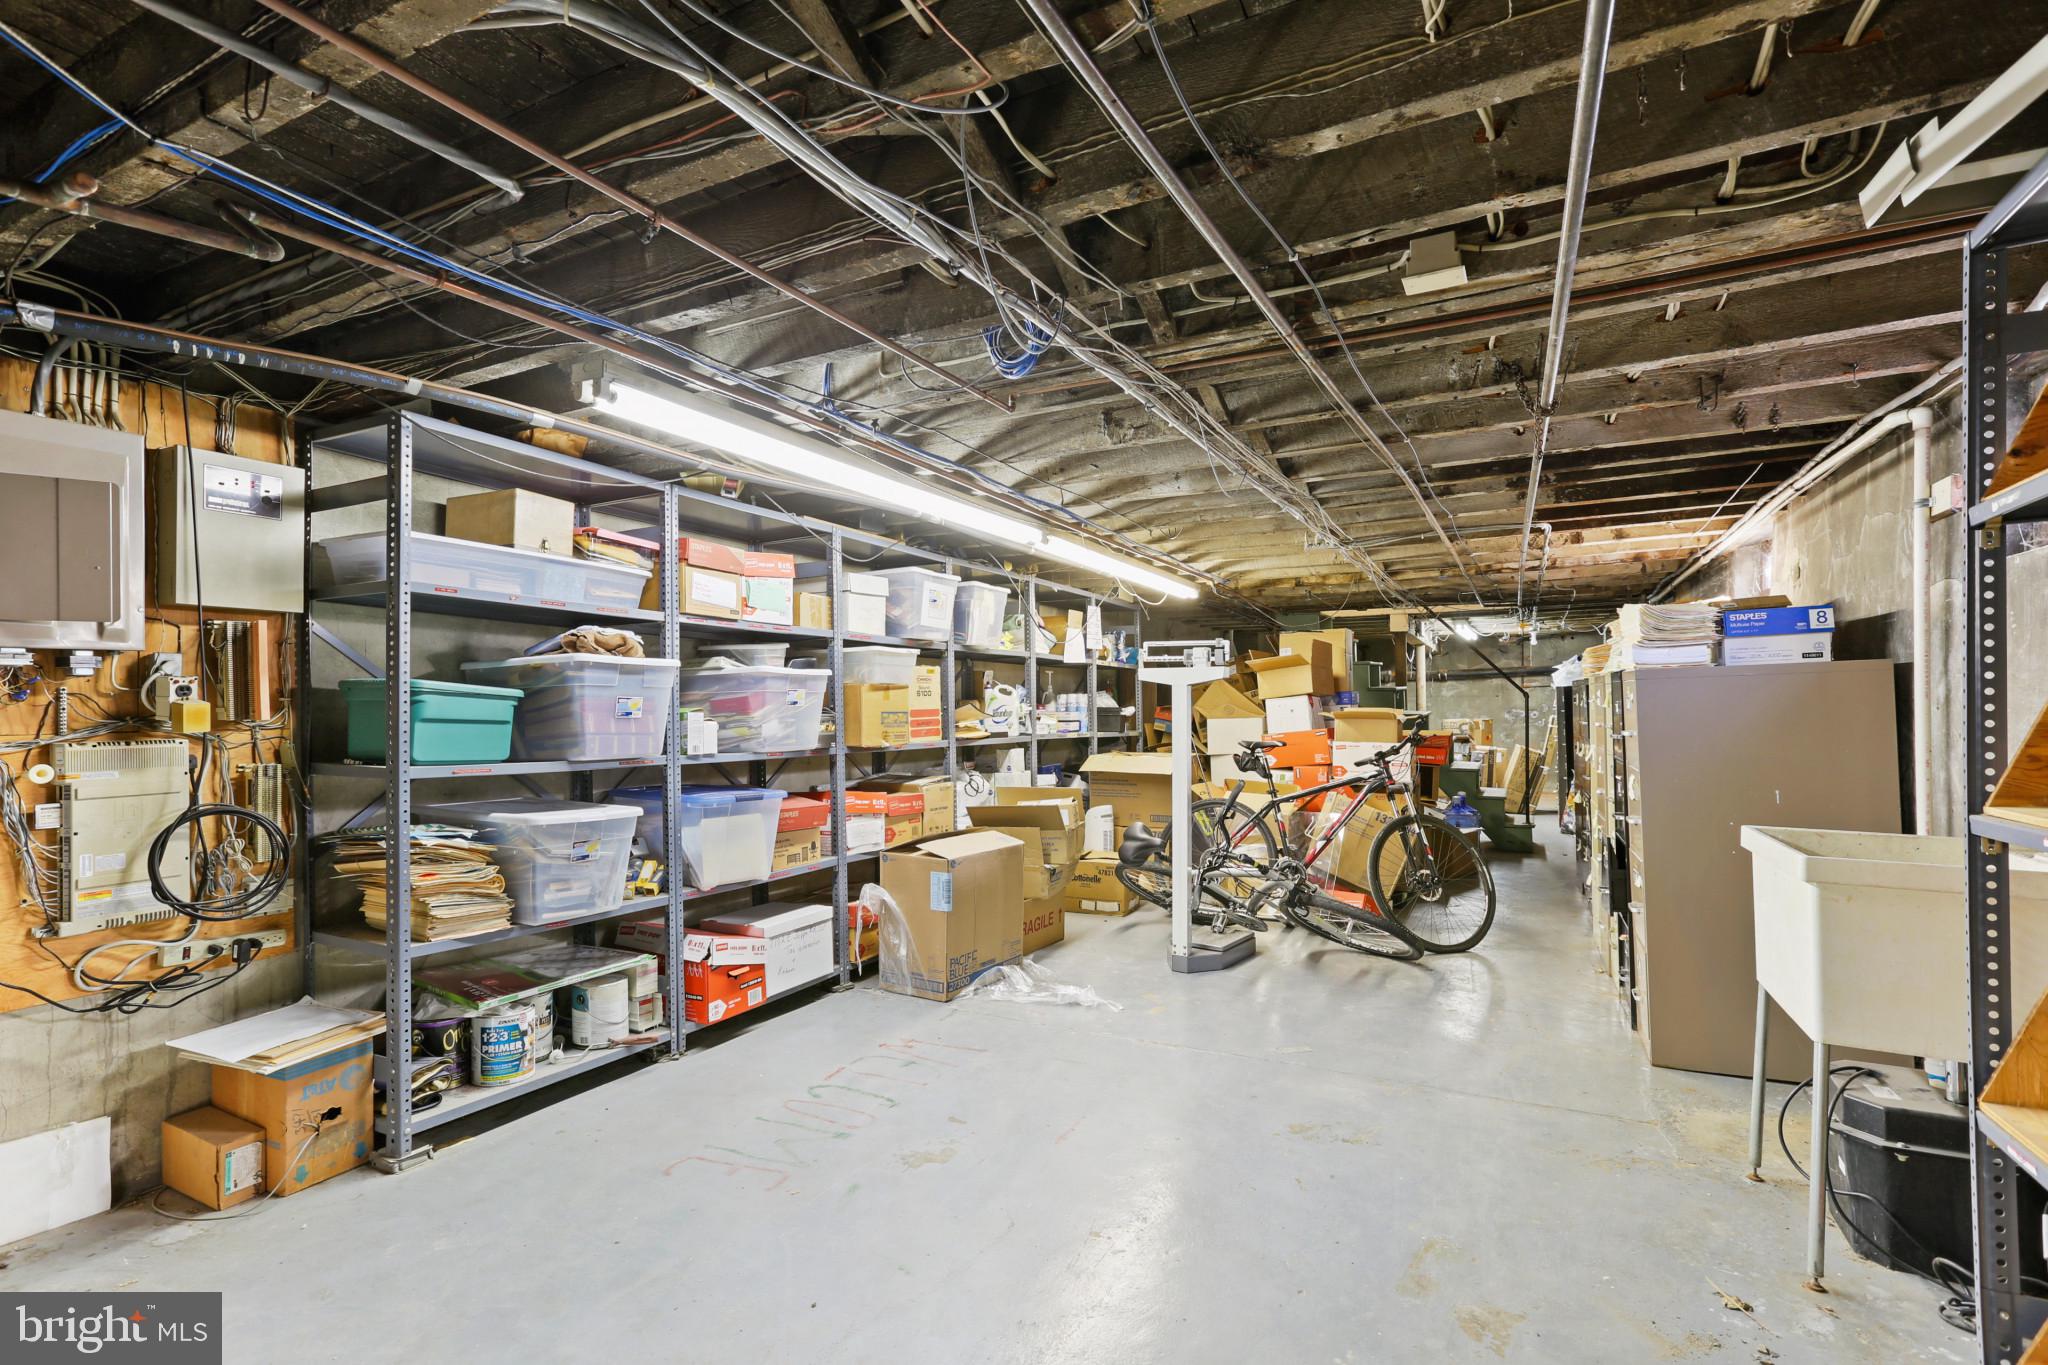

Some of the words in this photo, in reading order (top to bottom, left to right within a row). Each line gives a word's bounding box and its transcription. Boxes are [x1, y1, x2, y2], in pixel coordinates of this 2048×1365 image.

[1729, 612, 1767, 621] STAPLES
[1816, 610, 1828, 624] 8
[1022, 911, 1054, 937] RAGILE
[950, 949, 978, 966] PACIFIC
[949, 963, 969, 980] BLUE
[481, 1040, 524, 1054] PRIMER
